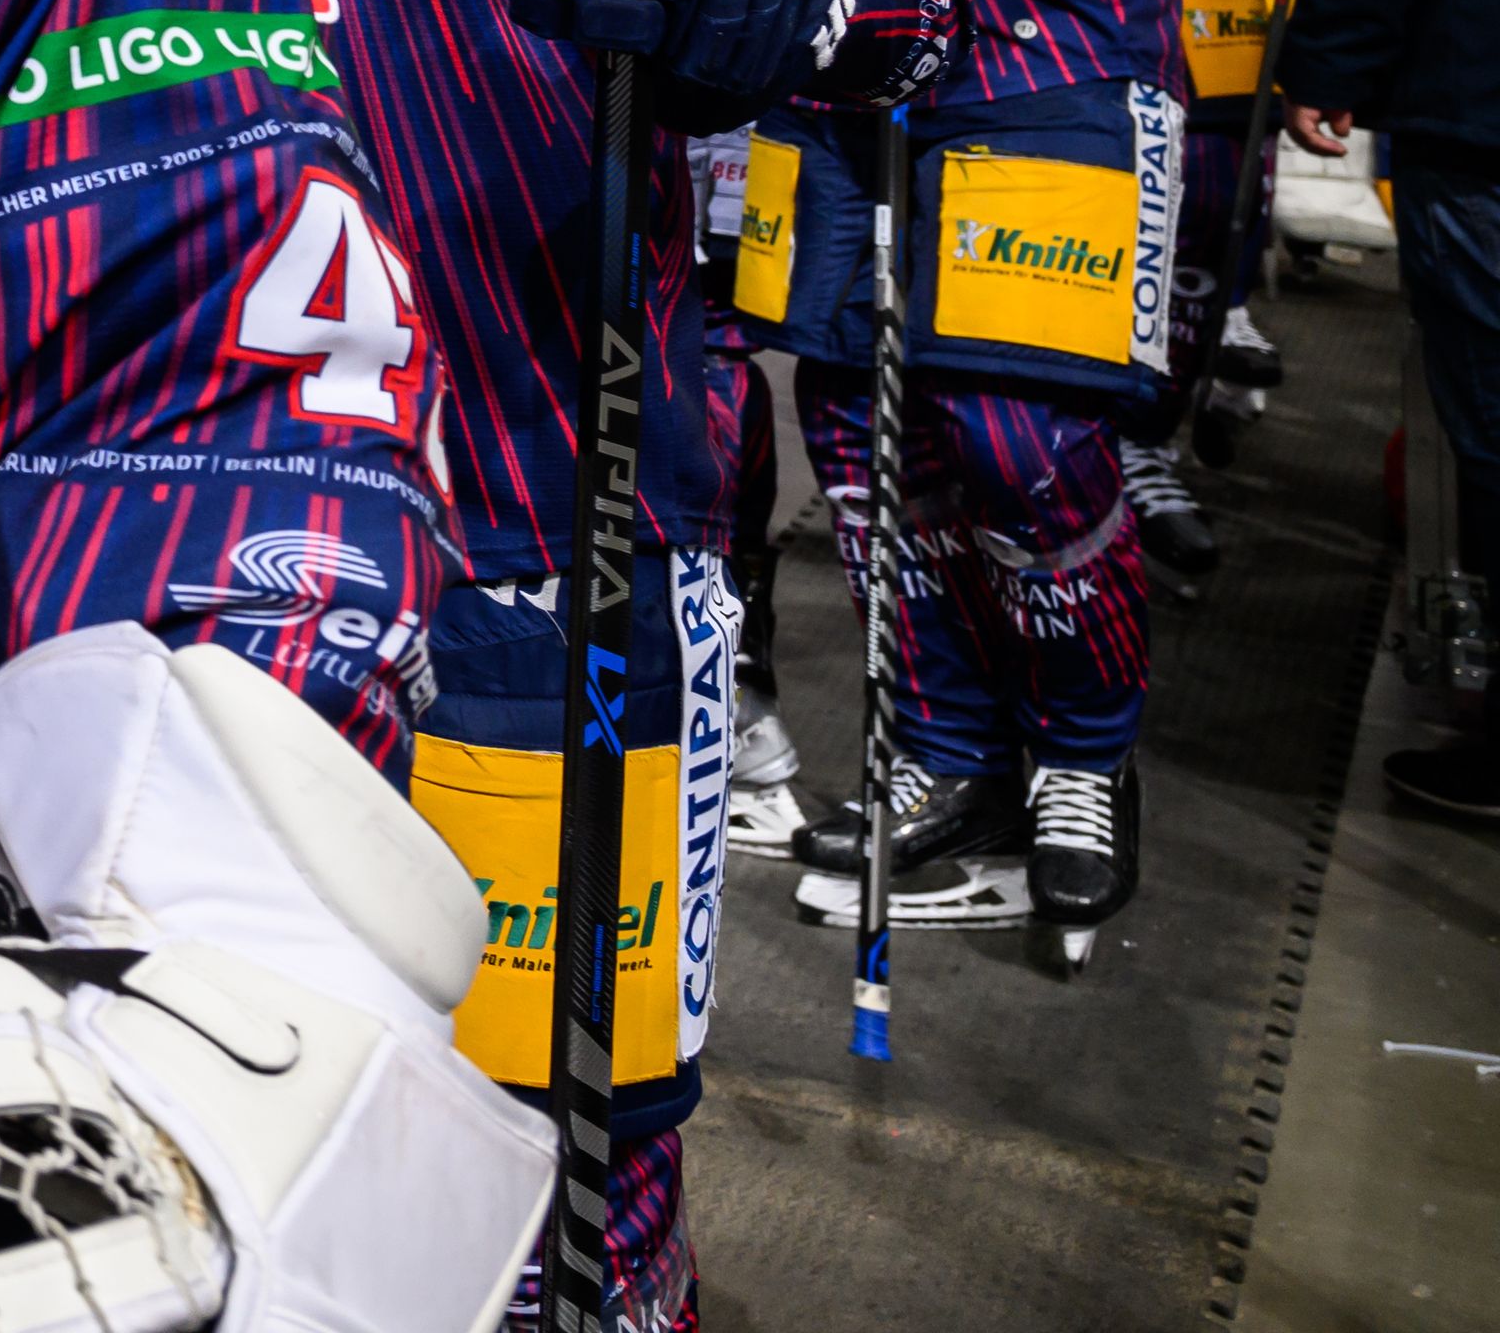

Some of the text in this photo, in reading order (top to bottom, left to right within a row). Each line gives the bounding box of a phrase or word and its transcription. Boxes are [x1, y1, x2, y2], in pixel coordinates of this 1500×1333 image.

[69, 26, 205, 91] LIGO
[51, 160, 150, 201] MEISTER
[160, 143, 216, 170] 2005
[227, 118, 282, 150] 2006
[1131, 81, 1169, 345] CONTIPARK
[986, 227, 1125, 283] Knittel
[232, 171, 420, 432] 4
[224, 455, 315, 476] BERLIN
[588, 319, 644, 615] ALPHA
[678, 547, 724, 1020] CONTIPARK
[473, 877, 665, 951] niel
[511, 956, 555, 973] Male
